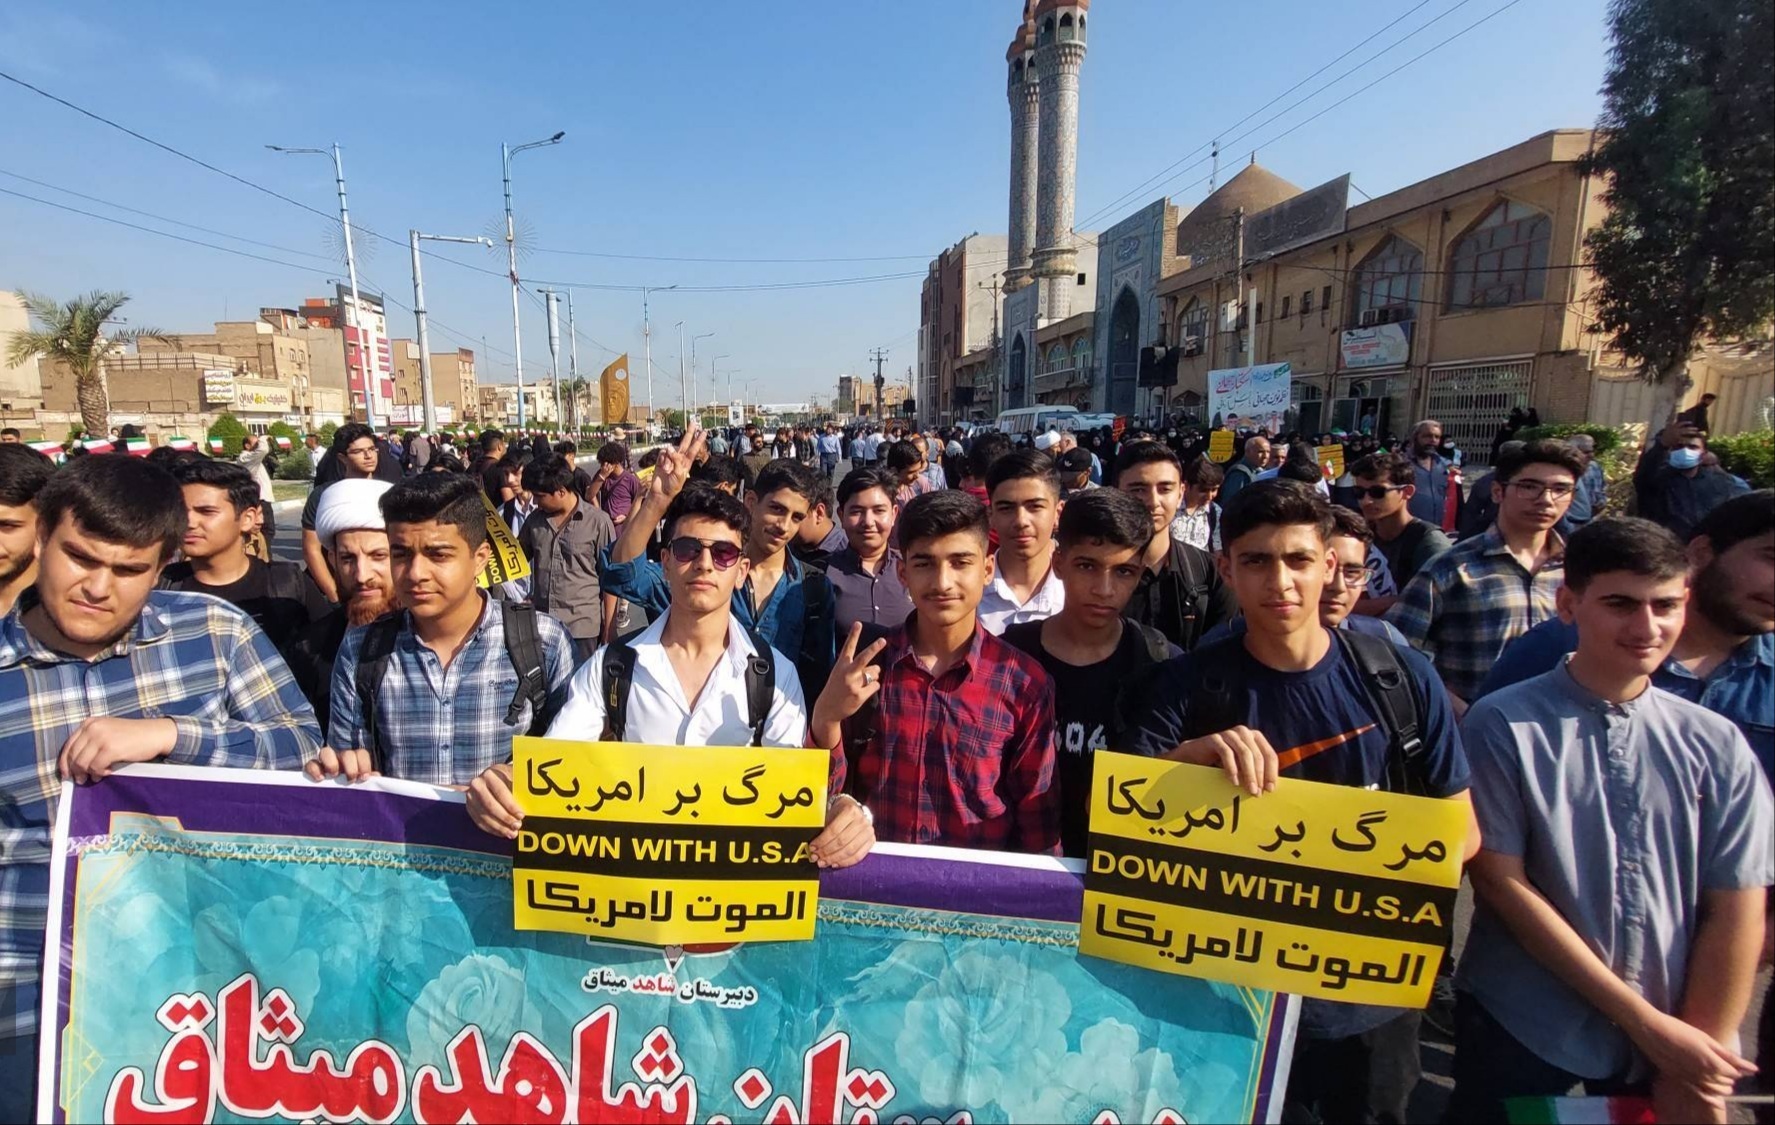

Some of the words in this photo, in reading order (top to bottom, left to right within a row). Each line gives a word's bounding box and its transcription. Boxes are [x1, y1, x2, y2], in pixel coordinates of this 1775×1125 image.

[1252, 391, 1269, 407] جهانی
[526, 758, 646, 812] امریکا
[662, 781, 701, 818] بر
[722, 764, 814, 818] مرگ
[1107, 774, 1240, 838] امریکا
[518, 830, 621, 860] DOWN
[632, 838, 717, 863] WITH
[728, 841, 814, 864] U.S.A
[1258, 814, 1305, 858] بر
[1332, 810, 1447, 871] مرگ
[527, 879, 673, 928] لامریکا
[686, 890, 807, 933] الموت
[1091, 850, 1208, 891] DOWN
[1220, 870, 1320, 911] WITH
[1333, 889, 1443, 927] U.S.A
[1095, 903, 1263, 964] لامریکا
[584, 970, 627, 992] میثاق
[633, 975, 675, 993] شاهد
[1276, 943, 1426, 990] الموت
[680, 981, 755, 1006] دبیرستان
[108, 976, 402, 1124] میثاق
[417, 1009, 694, 1124] شاهد
